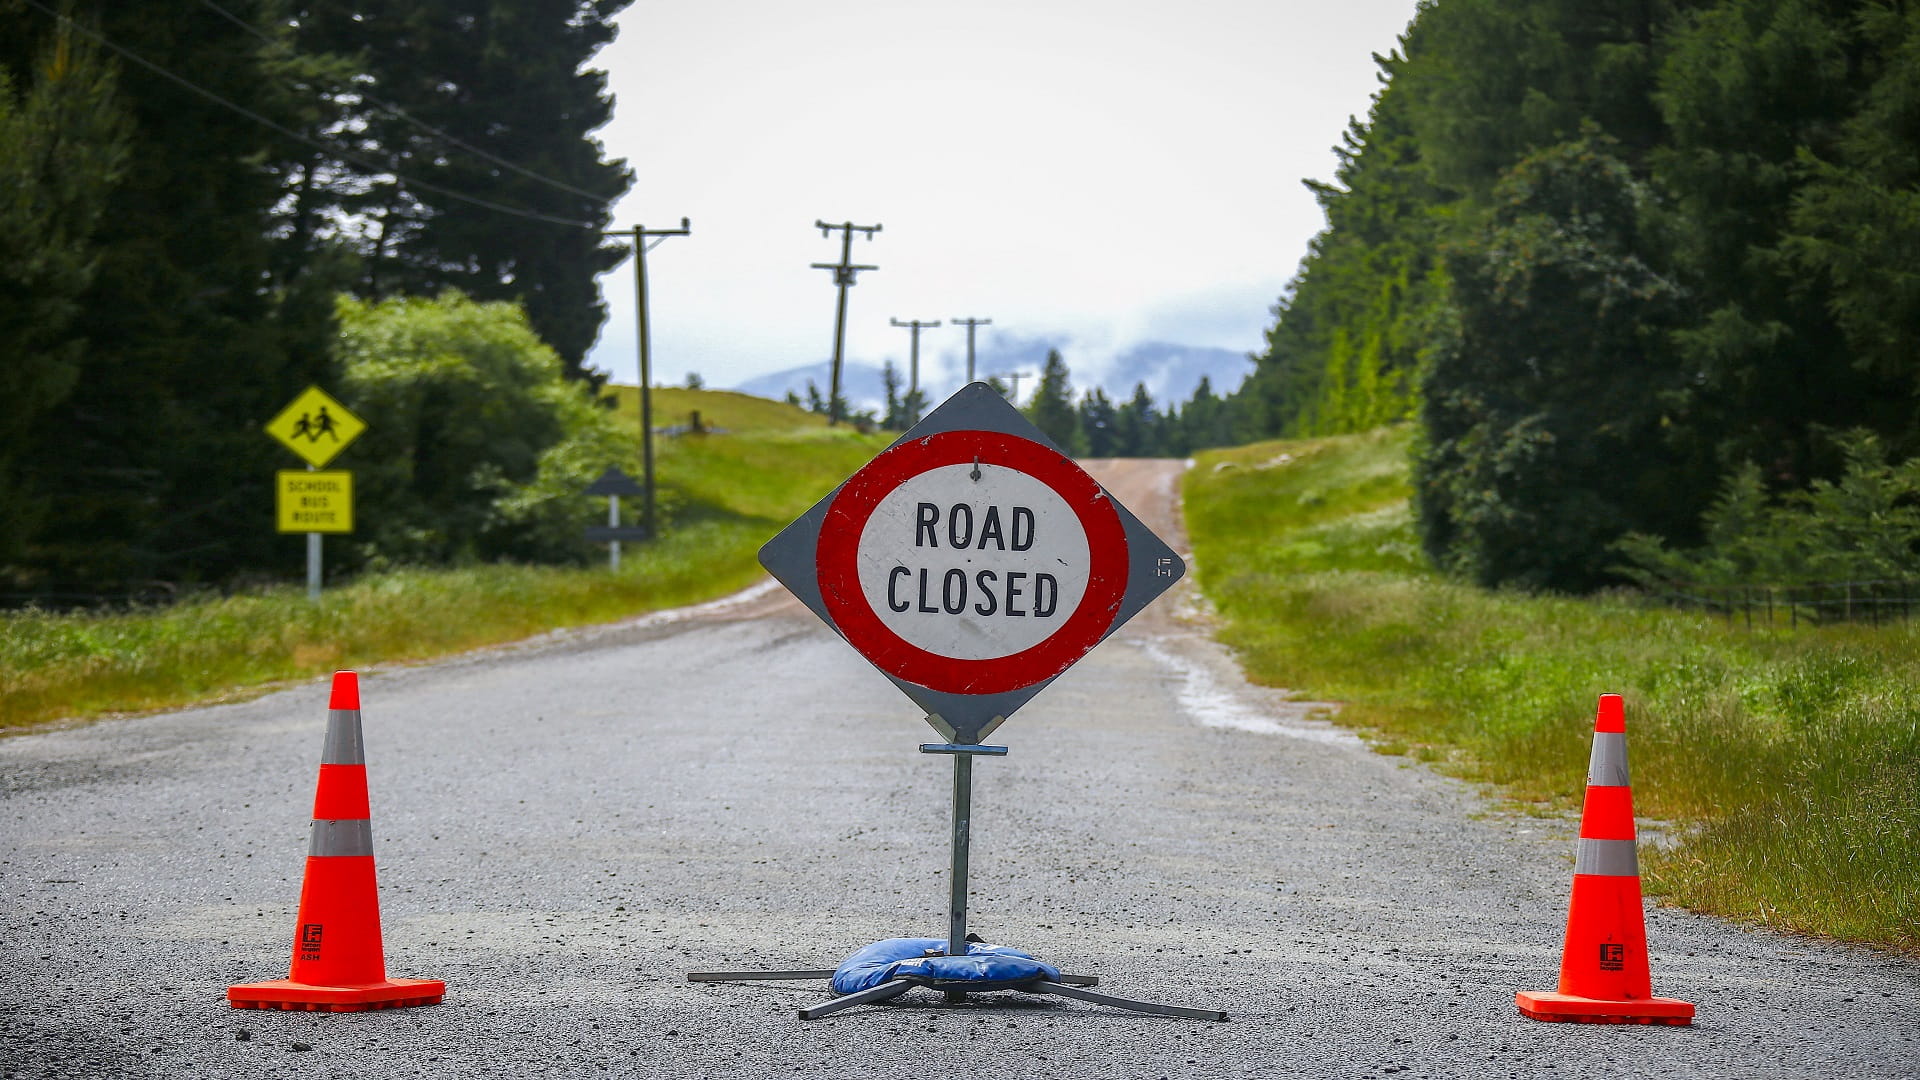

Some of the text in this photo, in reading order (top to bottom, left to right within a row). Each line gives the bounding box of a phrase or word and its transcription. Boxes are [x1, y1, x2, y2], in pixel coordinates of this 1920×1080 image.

[288, 480, 341, 493] SCHOOL
[301, 496, 329, 508] BUS
[292, 511, 336, 523] ROUTE
[915, 502, 1035, 551] ROAD
[887, 565, 1058, 617] CLOSED
[301, 953, 320, 961] ASH
